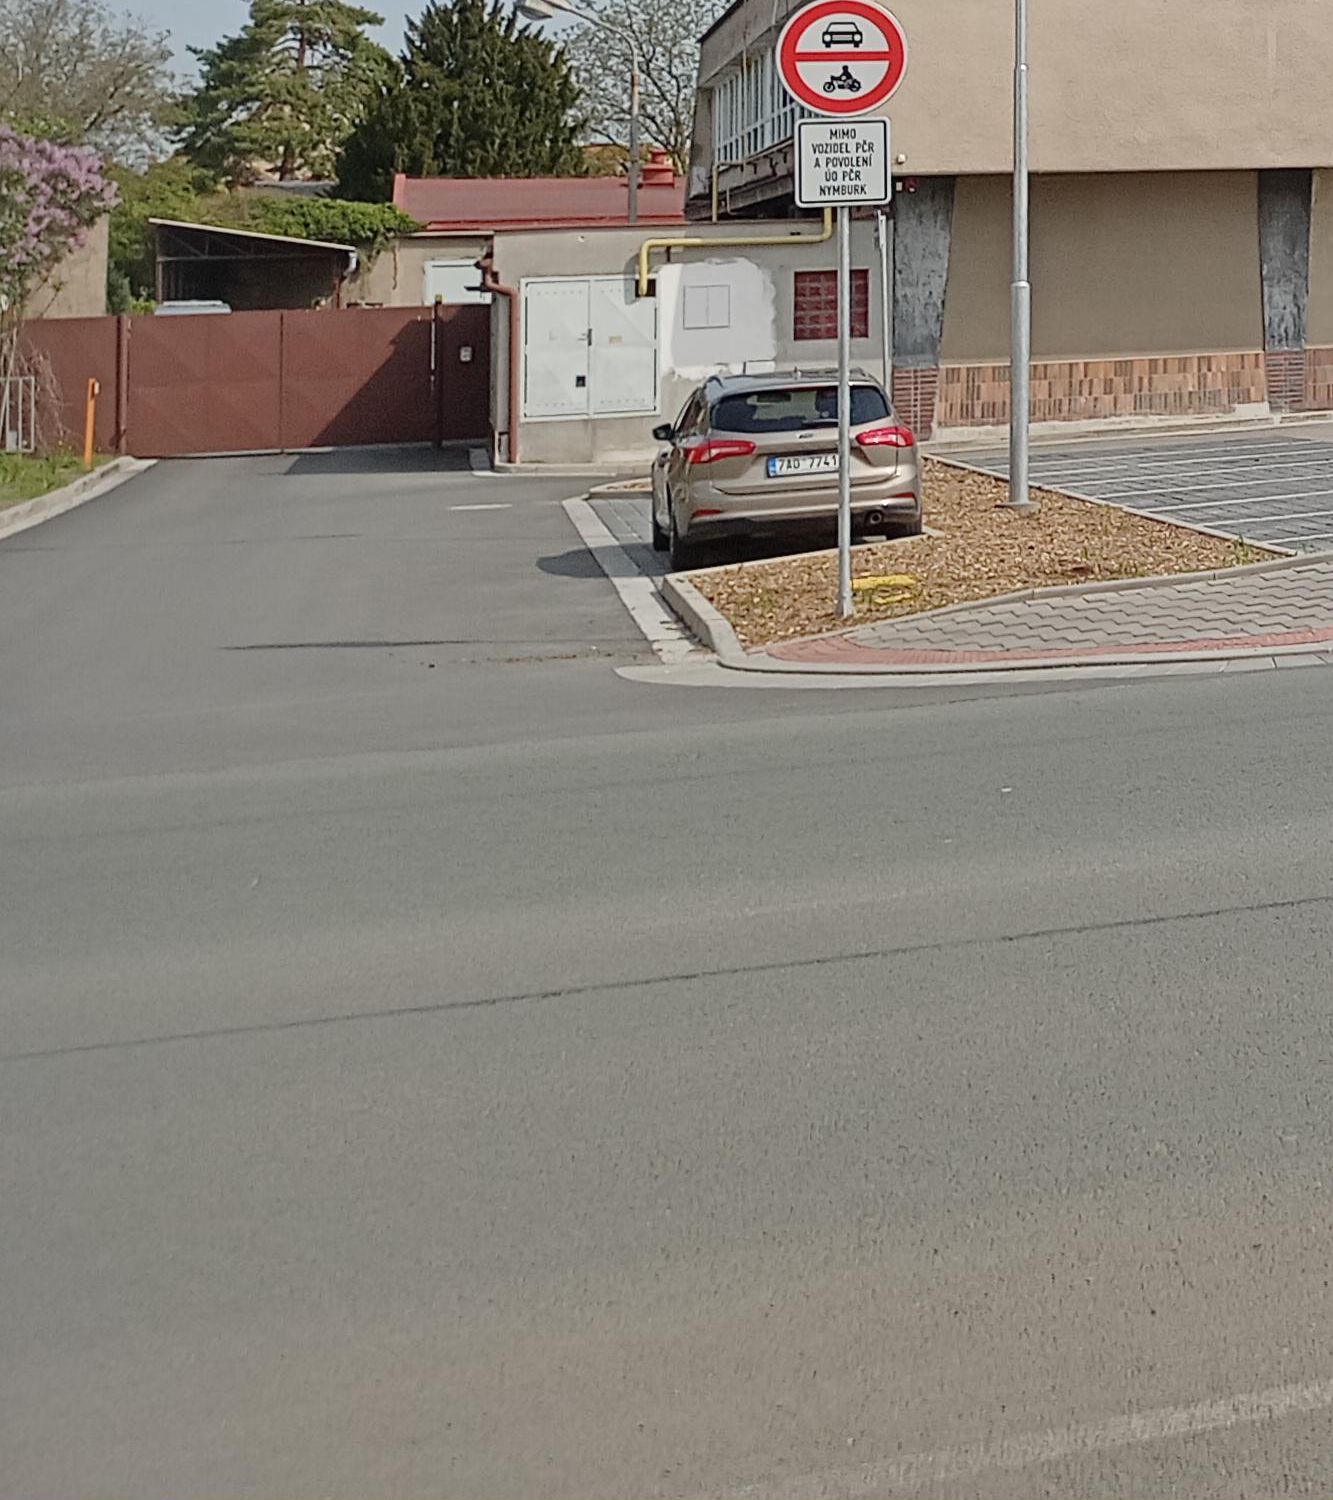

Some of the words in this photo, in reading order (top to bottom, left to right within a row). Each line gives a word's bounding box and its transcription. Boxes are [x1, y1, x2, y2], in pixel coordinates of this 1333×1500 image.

[829, 128, 857, 140] MIMO
[812, 142, 851, 154] VOZIDEL
[855, 140, 875, 153] PČR
[814, 157, 821, 168] A
[825, 153, 872, 168] POVOLENÍ
[842, 168, 862, 181] PČR
[819, 184, 867, 196] NYMBURK
